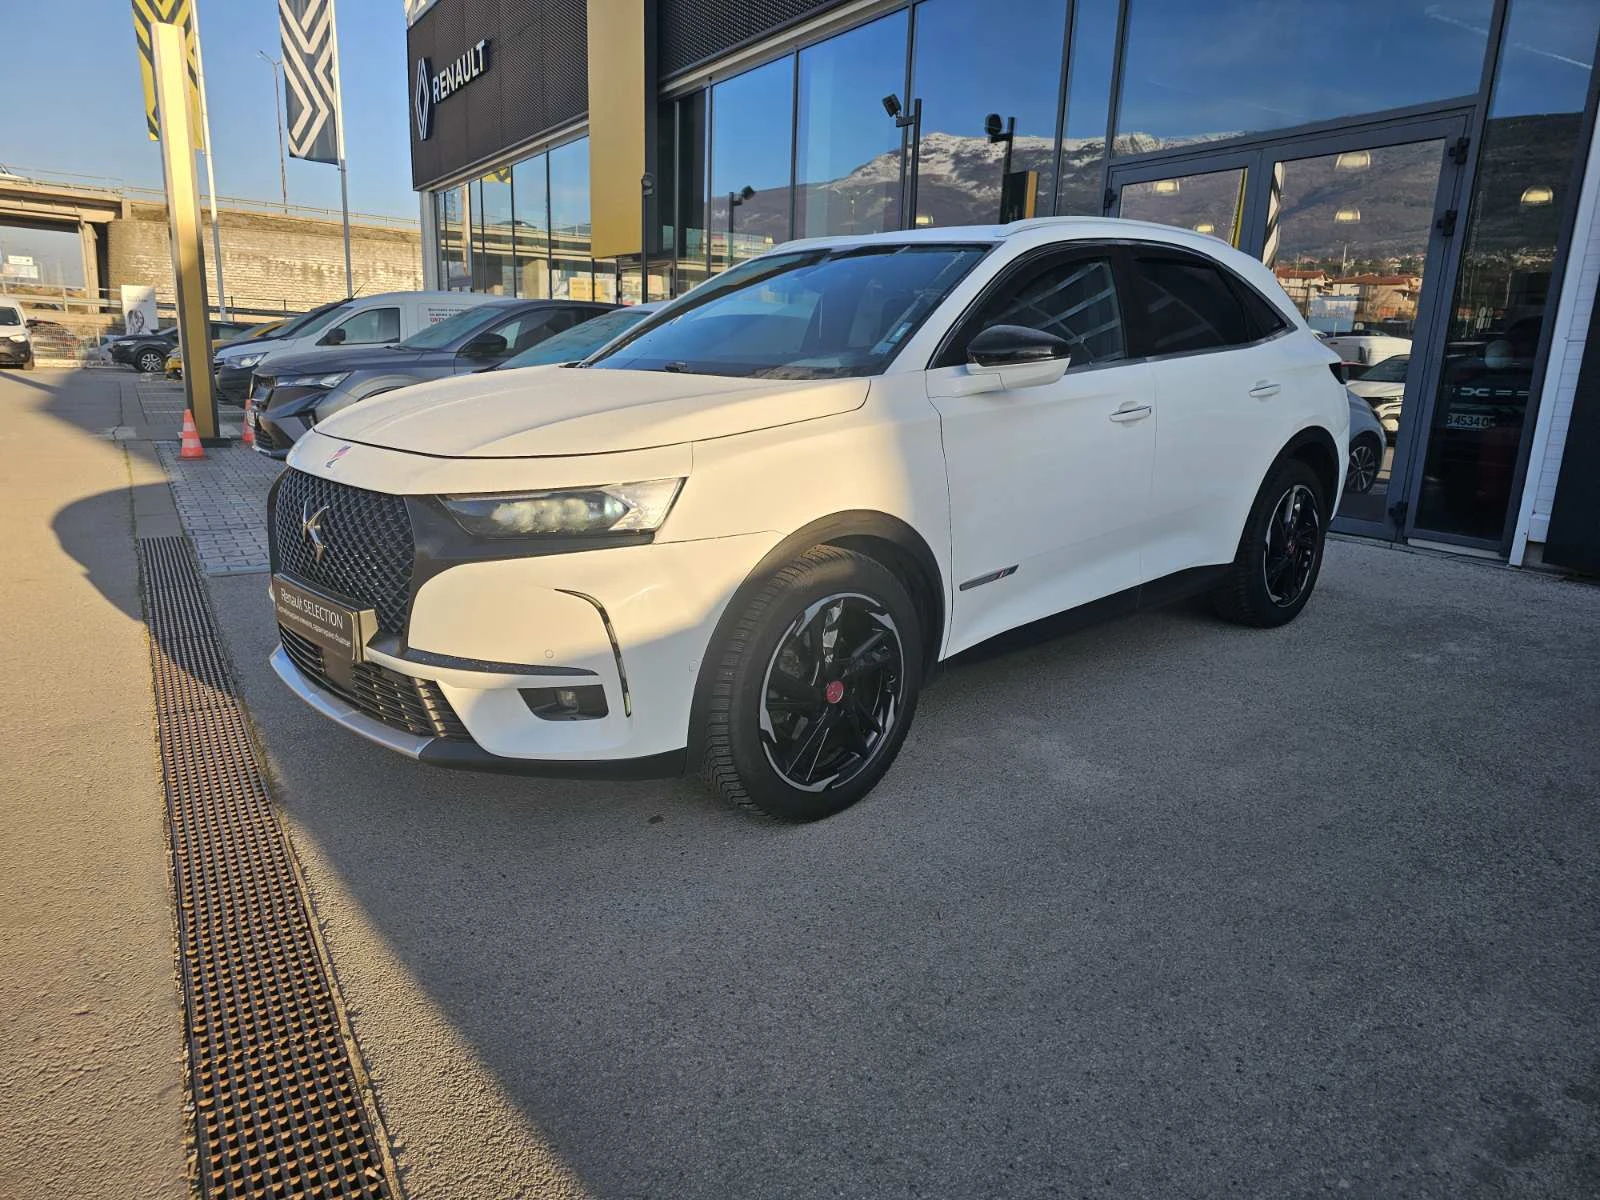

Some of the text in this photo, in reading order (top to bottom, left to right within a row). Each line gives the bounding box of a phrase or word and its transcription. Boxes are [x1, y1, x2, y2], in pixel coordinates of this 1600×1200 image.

[432, 39, 485, 104] RENAULT
[280, 587, 303, 611] Renault
[303, 599, 343, 630] SELECTION
